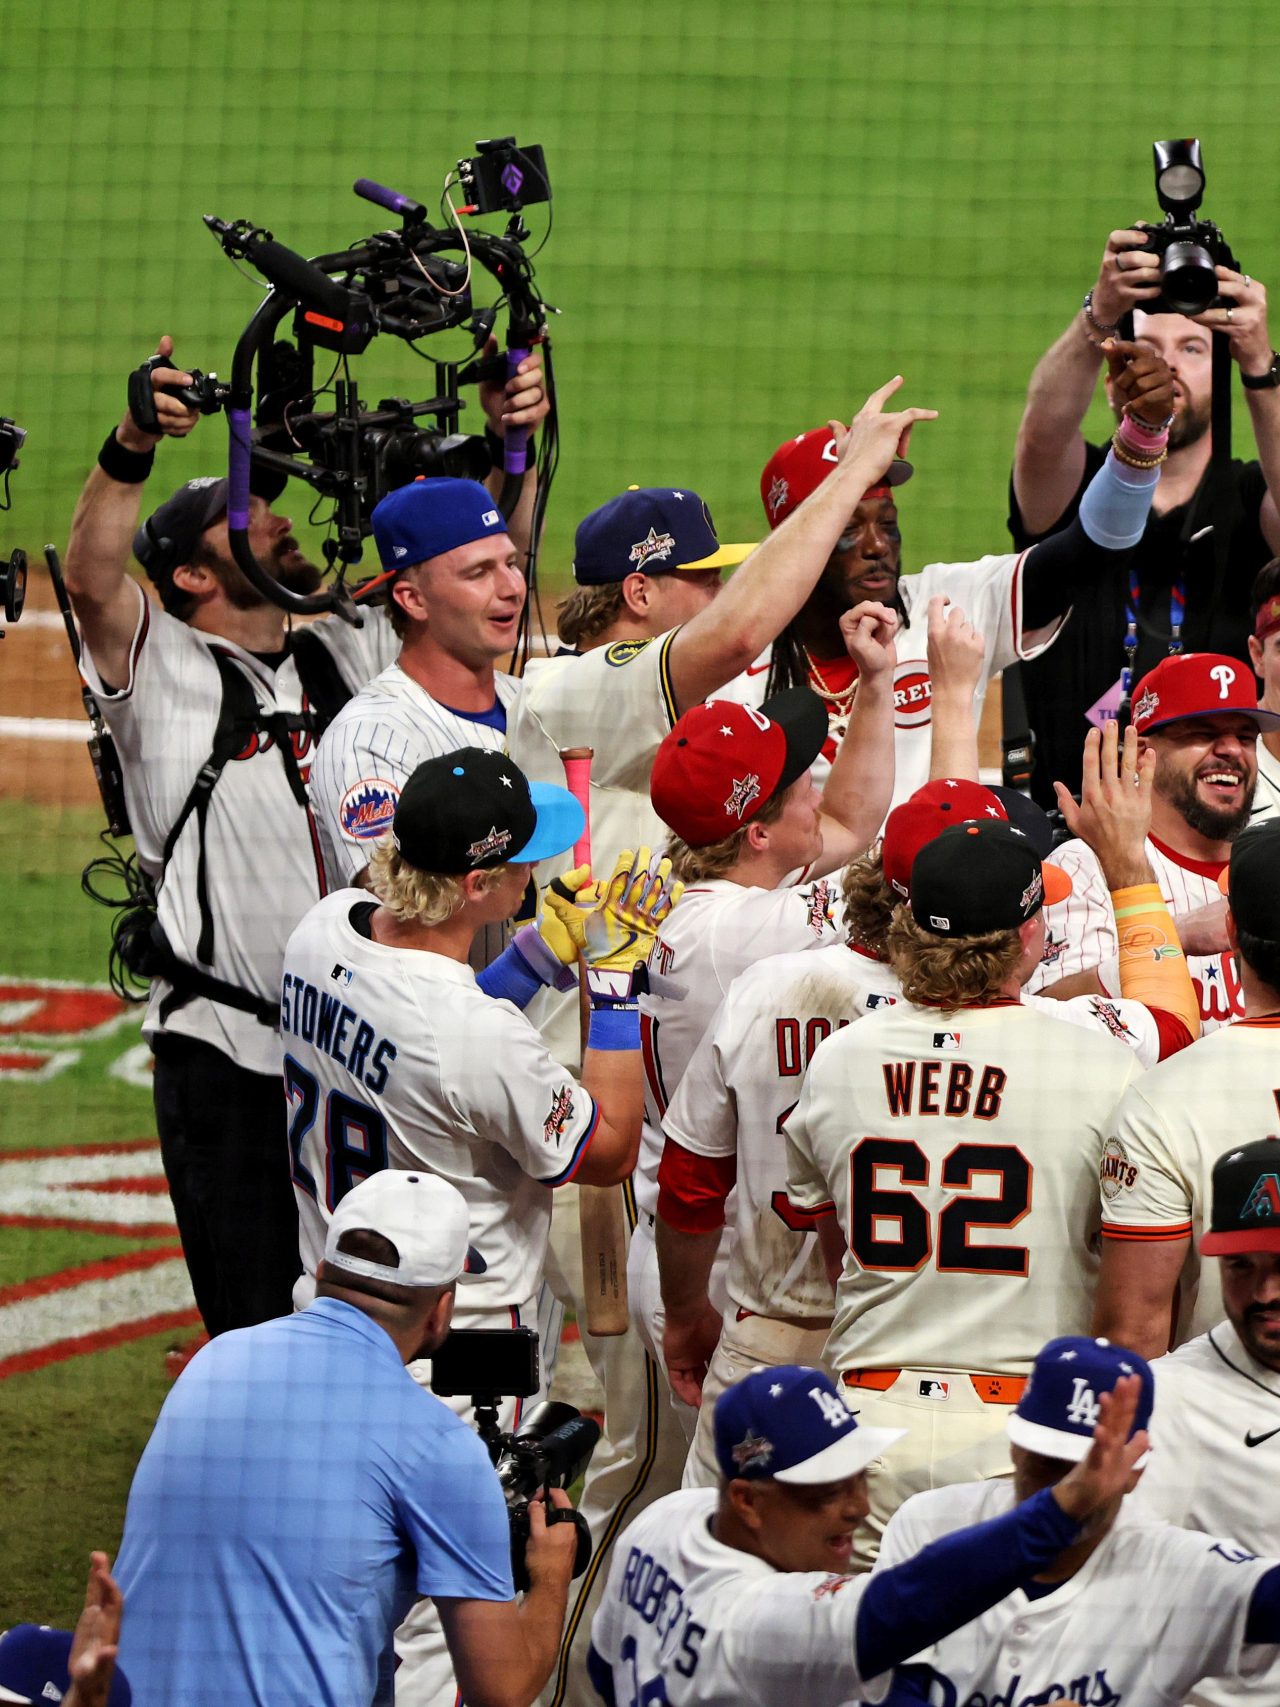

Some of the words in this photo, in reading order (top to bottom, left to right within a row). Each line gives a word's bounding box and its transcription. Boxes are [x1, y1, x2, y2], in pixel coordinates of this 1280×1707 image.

[1210, 664, 1236, 699] P
[351, 798, 395, 827] Mets
[281, 972, 398, 1096] STOWERS
[882, 1061, 1007, 1121] WEBB
[850, 1136, 1034, 1278] 62
[808, 1387, 850, 1428] LA
[1066, 1378, 1101, 1426] LA
[619, 1546, 706, 1678] ROBES
